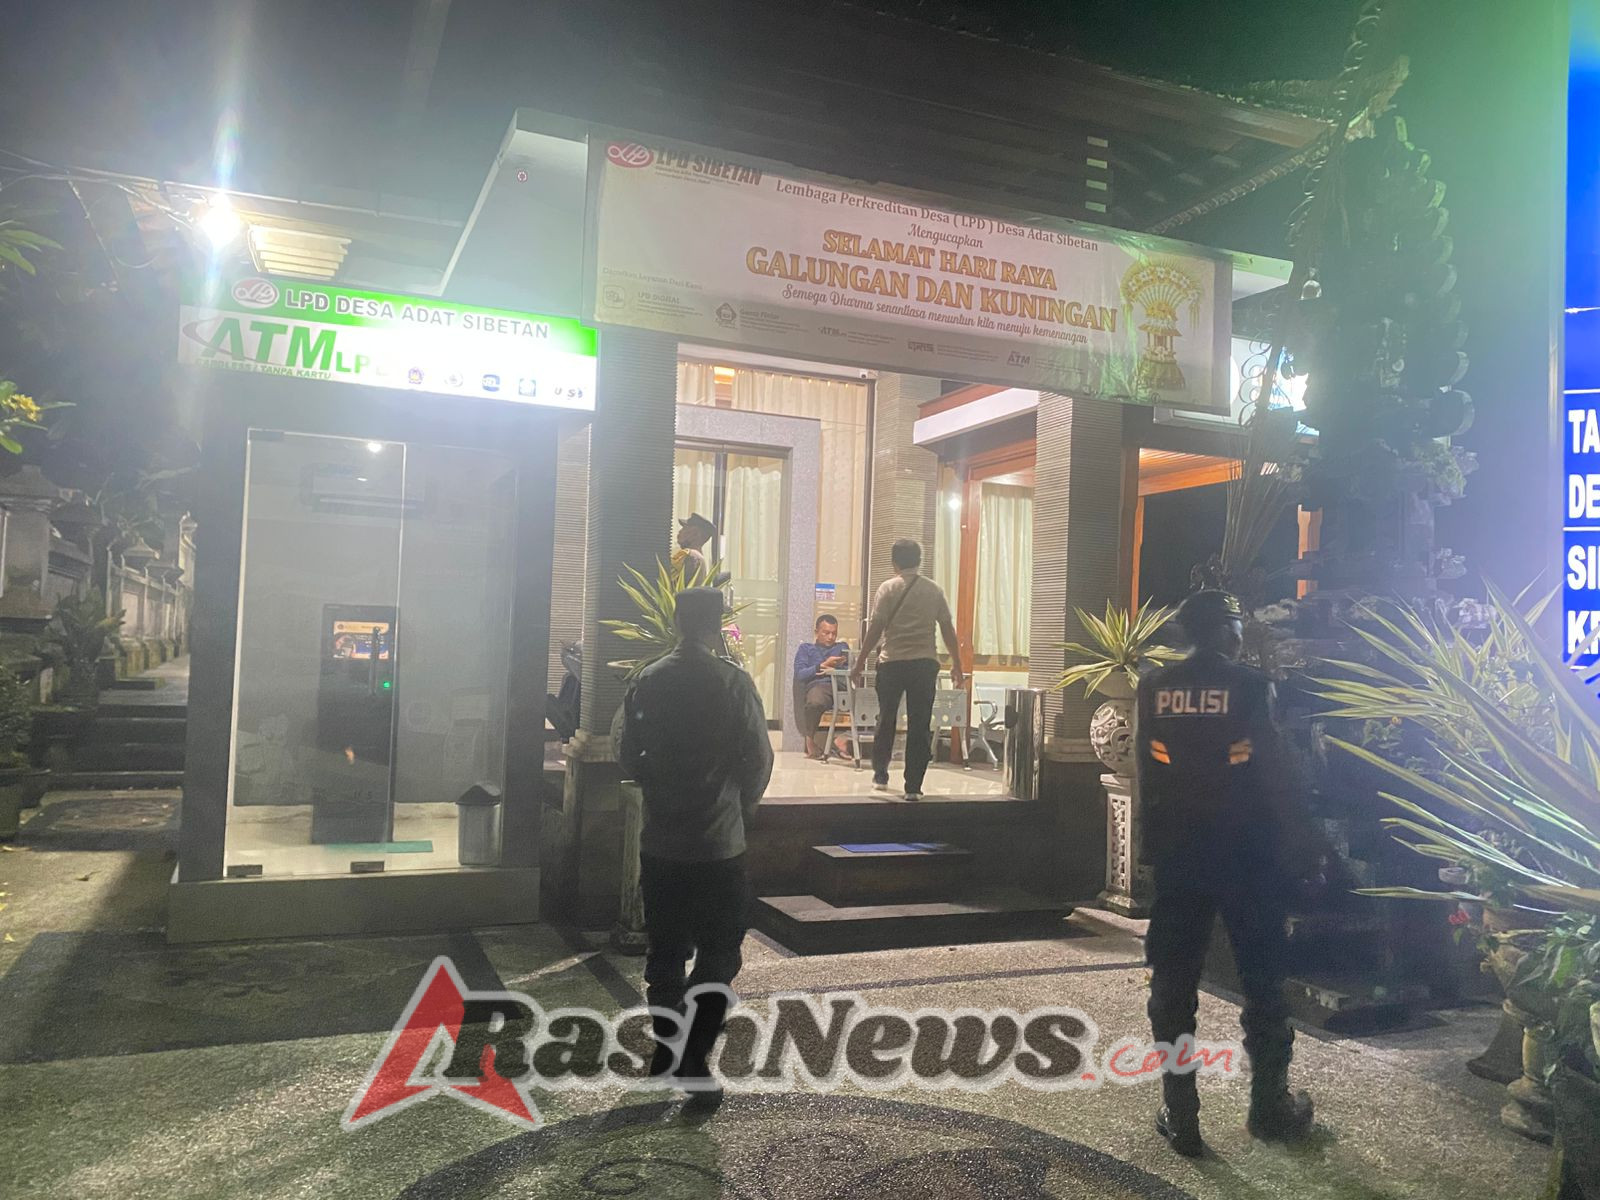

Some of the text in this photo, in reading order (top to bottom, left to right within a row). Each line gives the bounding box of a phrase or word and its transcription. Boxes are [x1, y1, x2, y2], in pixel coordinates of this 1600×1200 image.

[692, 154, 763, 186] SIBETAN
[776, 179, 836, 204] Lembaga
[840, 191, 918, 217] Perkreditan
[920, 207, 950, 223] Desa
[961, 215, 986, 230] LPD
[997, 223, 1025, 237] Desa
[1027, 227, 1054, 243] Adat
[1056, 233, 1098, 251] Sibetan
[908, 223, 984, 250] Mengucapkan
[822, 229, 1058, 291] SELAMAT HARI RAYA
[746, 246, 1118, 333] GALUNGAN DAN KUNINGAN
[286, 289, 548, 339] LPD DESA ADAT SIBETAN
[782, 283, 1088, 345] Semoga Dharma senantiasa menuntun kita menuju kemenangan
[202, 316, 337, 371] ATM
[296, 368, 332, 379] KARTU
[1568, 474, 1600, 519] DE
[1567, 545, 1600, 590] SI
[1155, 690, 1229, 714] POLISI
